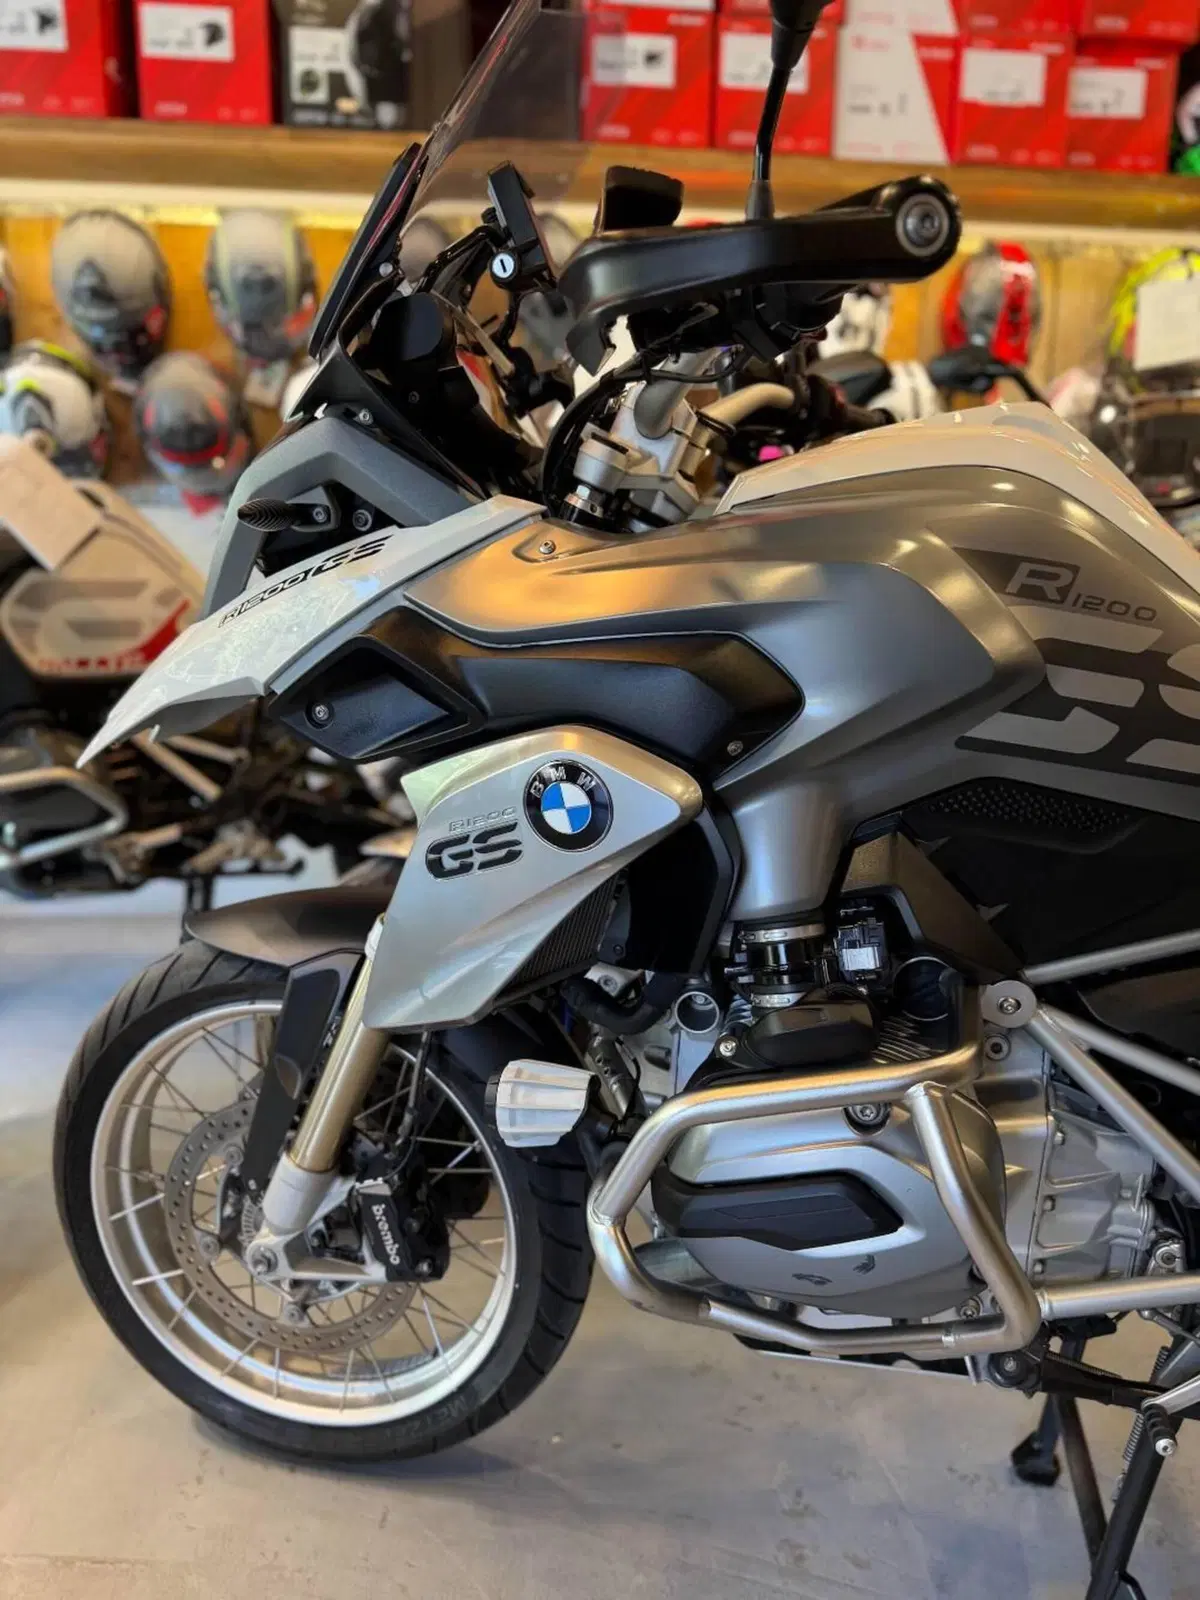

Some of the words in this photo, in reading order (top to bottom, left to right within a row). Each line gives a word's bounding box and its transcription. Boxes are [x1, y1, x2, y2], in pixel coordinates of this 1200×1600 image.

[530, 766, 598, 799] BMW
[449, 806, 518, 834] R1200
[425, 820, 524, 880] GS
[371, 1203, 400, 1265] brembo
